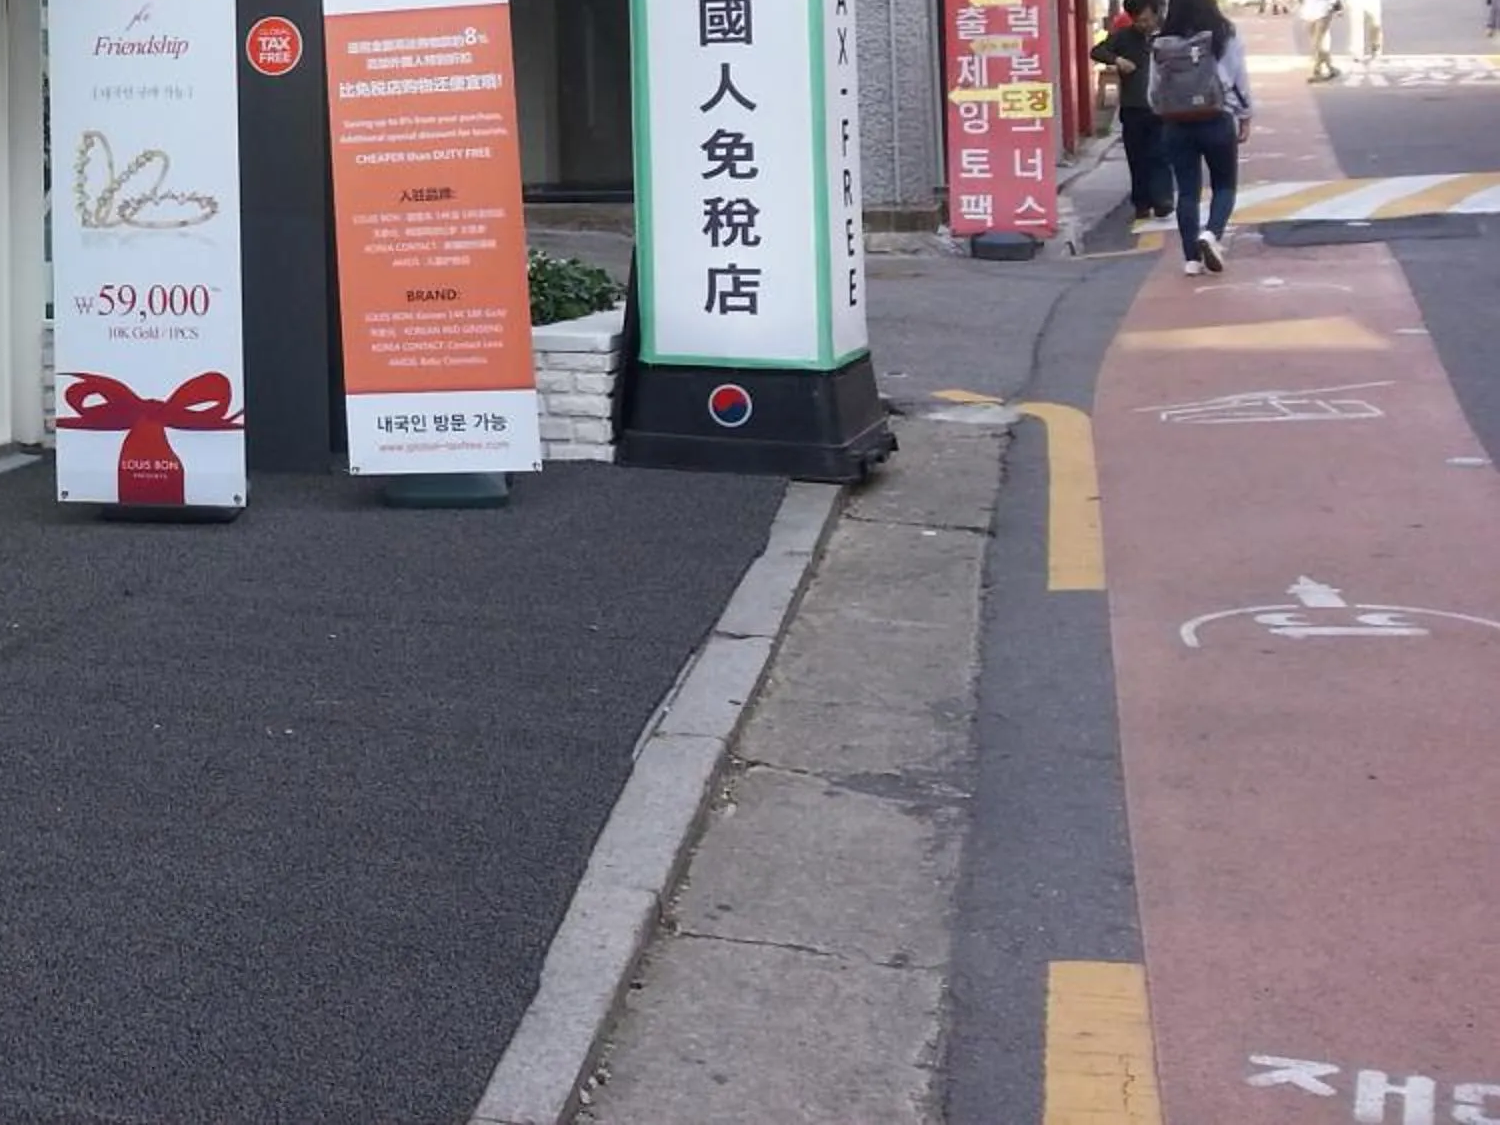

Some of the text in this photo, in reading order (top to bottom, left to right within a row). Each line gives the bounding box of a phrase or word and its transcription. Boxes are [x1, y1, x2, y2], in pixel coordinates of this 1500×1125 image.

[93, 35, 190, 60] Friendship
[257, 36, 292, 52] TAX
[259, 52, 293, 63] FREE
[1001, 88, 1049, 113] 도장
[377, 412, 509, 434] 내국인 방문 가능
